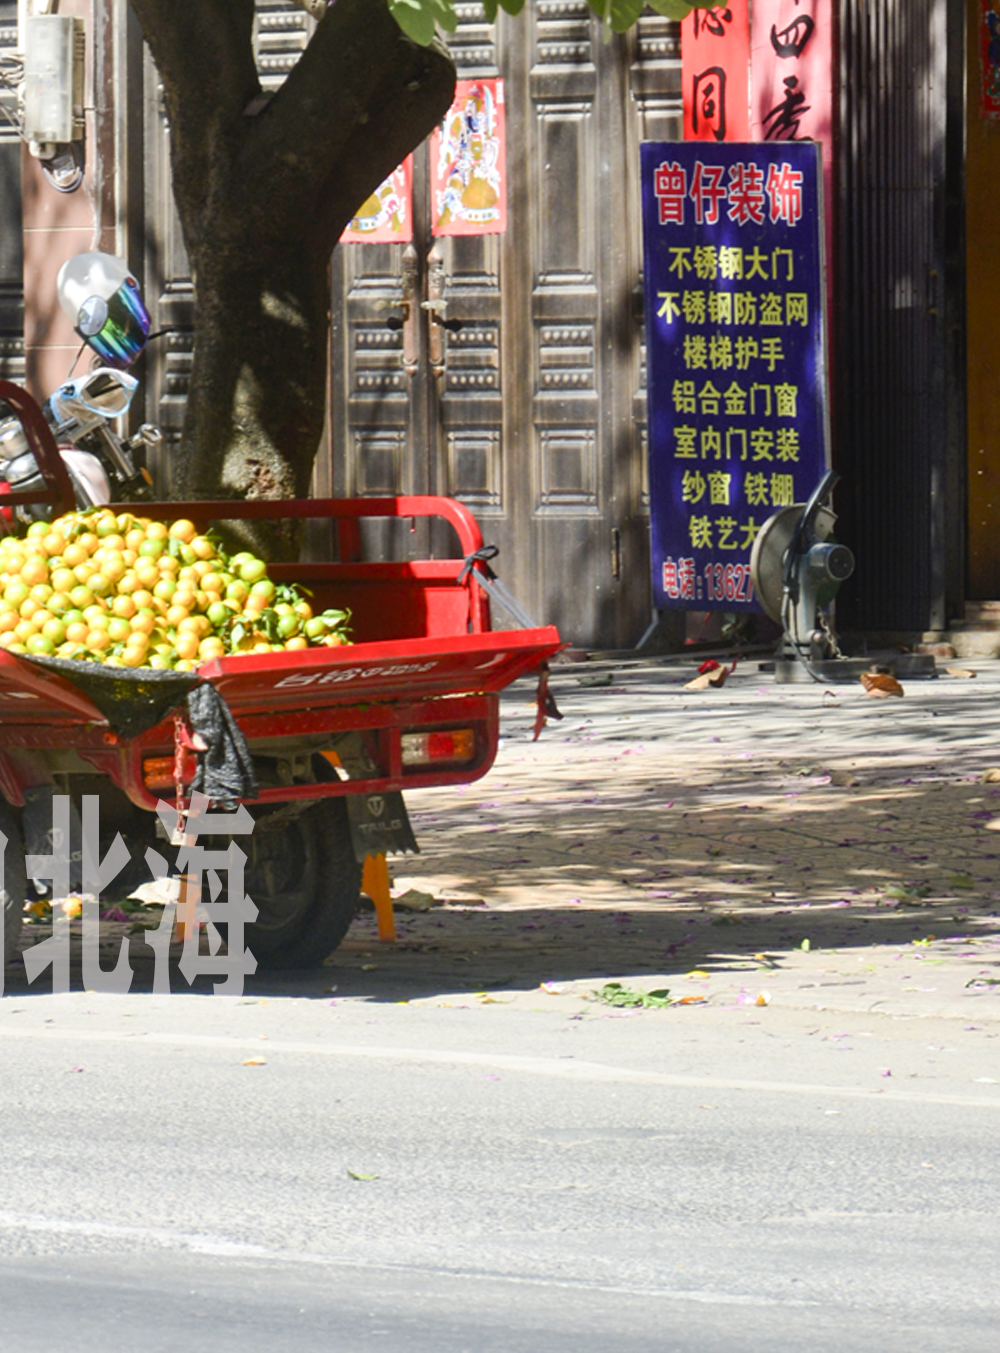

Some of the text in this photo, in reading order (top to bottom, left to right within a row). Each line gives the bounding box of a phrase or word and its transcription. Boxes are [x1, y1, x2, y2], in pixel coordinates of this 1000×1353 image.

[654, 162, 804, 227] 曾仔装饰
[668, 246, 795, 281] 不锈钢大门
[657, 291, 809, 327] 不锈钢防盗网
[683, 336, 785, 372] 楼梯护手
[672, 380, 799, 418] 铝合金门窗
[674, 425, 801, 463] 室内门安装
[682, 471, 795, 507] 纱窗 铁棚
[689, 515, 761, 550] 铁艺大
